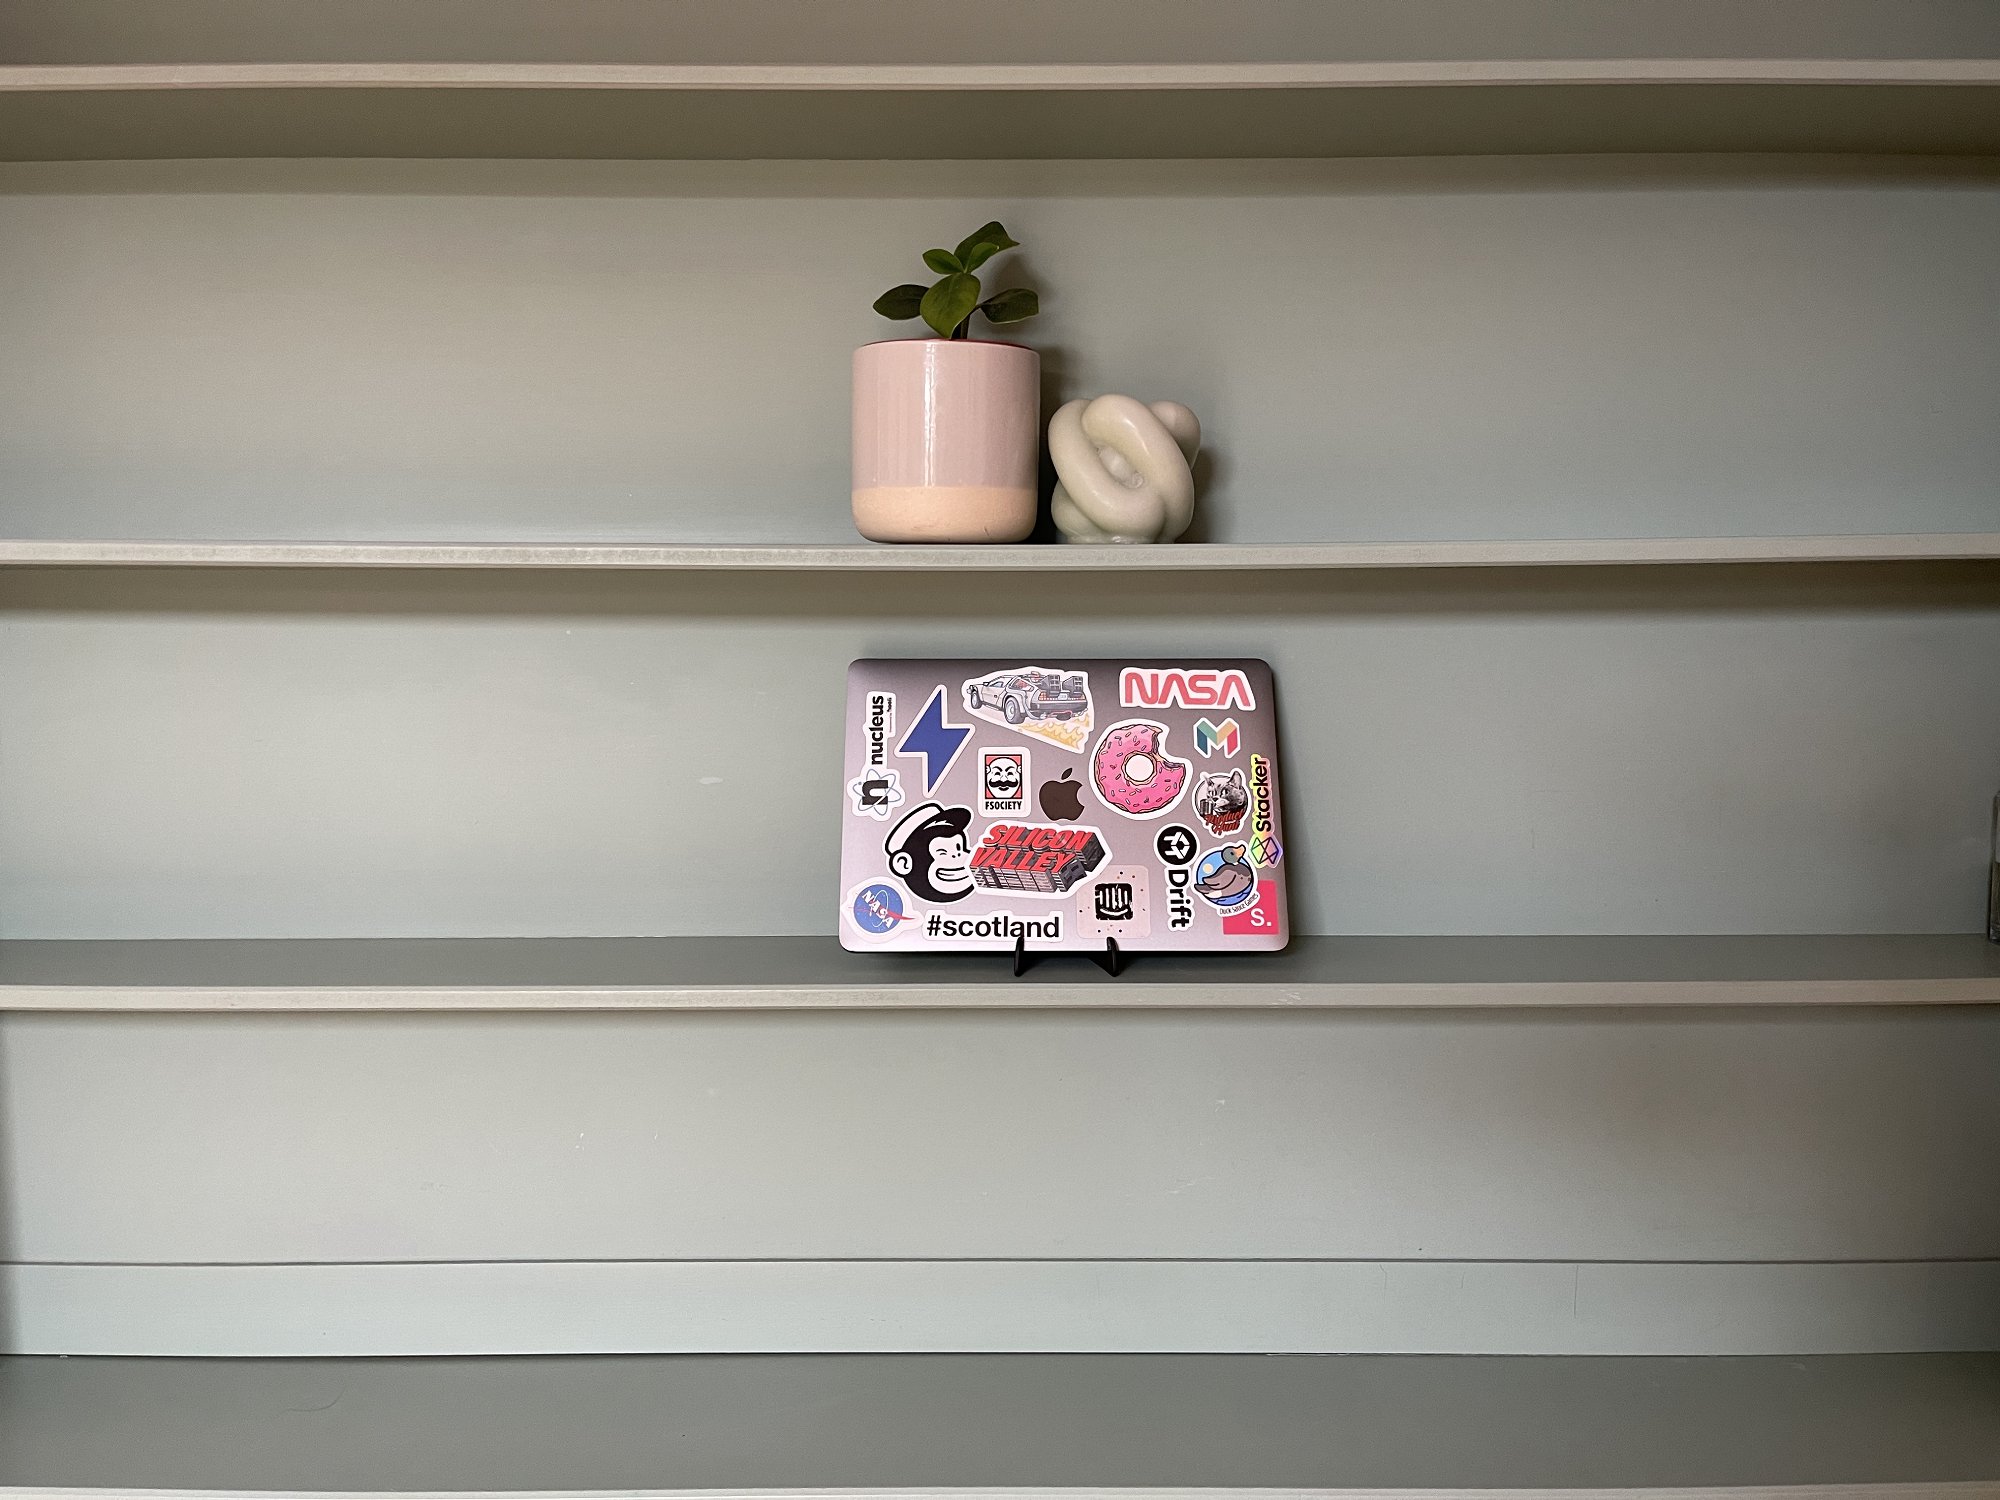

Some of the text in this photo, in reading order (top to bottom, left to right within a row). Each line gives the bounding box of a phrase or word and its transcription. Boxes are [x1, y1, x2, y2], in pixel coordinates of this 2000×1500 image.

[1125, 672, 1251, 707] NASA
[868, 695, 884, 765] nucleus
[985, 801, 1022, 811] FSOCIETY
[1253, 757, 1272, 832] Stacker
[1204, 809, 1244, 826] Product
[983, 824, 1093, 853] SILICON
[969, 847, 1076, 873] VALLEY
[862, 890, 894, 928] NASA
[1168, 869, 1192, 928] Drift
[926, 915, 1060, 938] #scotland
[1250, 907, 1272, 927] S.
